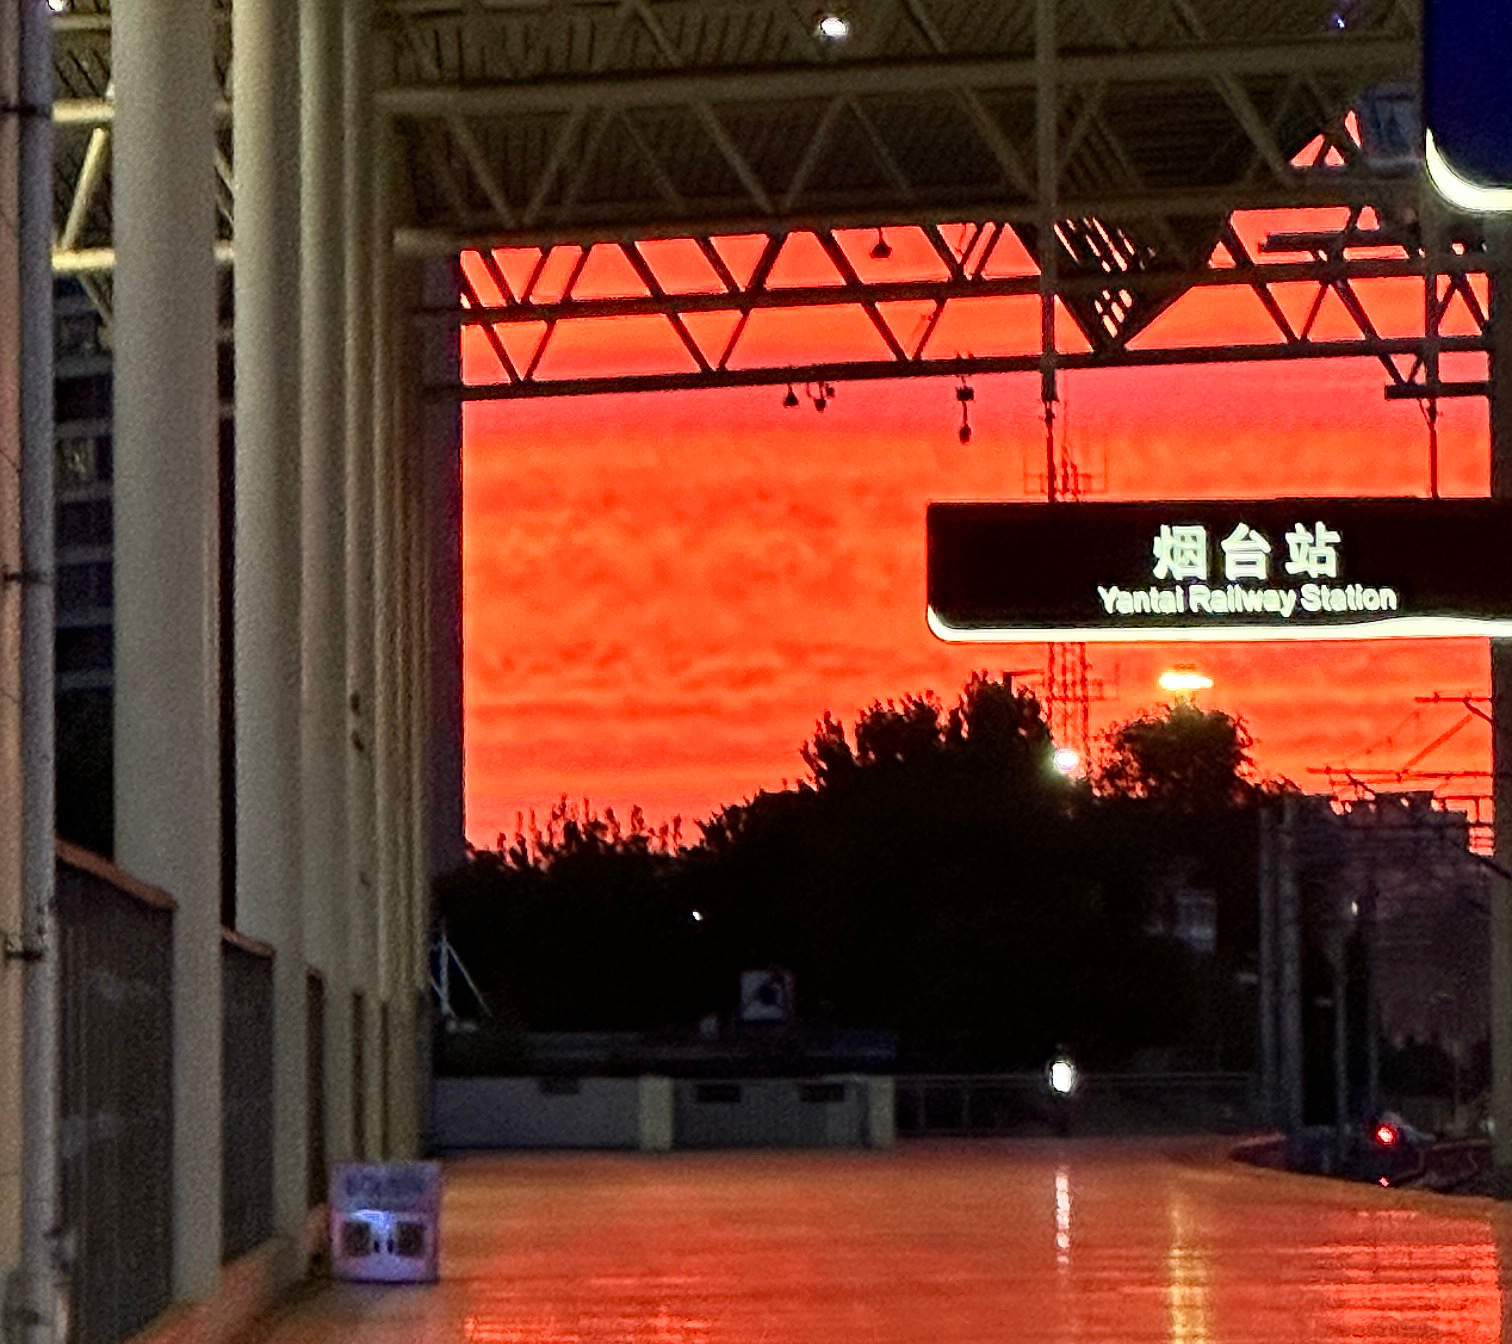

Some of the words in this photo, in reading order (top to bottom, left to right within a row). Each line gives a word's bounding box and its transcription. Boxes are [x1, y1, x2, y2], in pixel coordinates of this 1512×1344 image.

[1153, 521, 1342, 580] 烟台站
[1098, 585, 1184, 614] Yantai
[1189, 584, 1296, 617] Railway
[1300, 583, 1397, 612] Station
